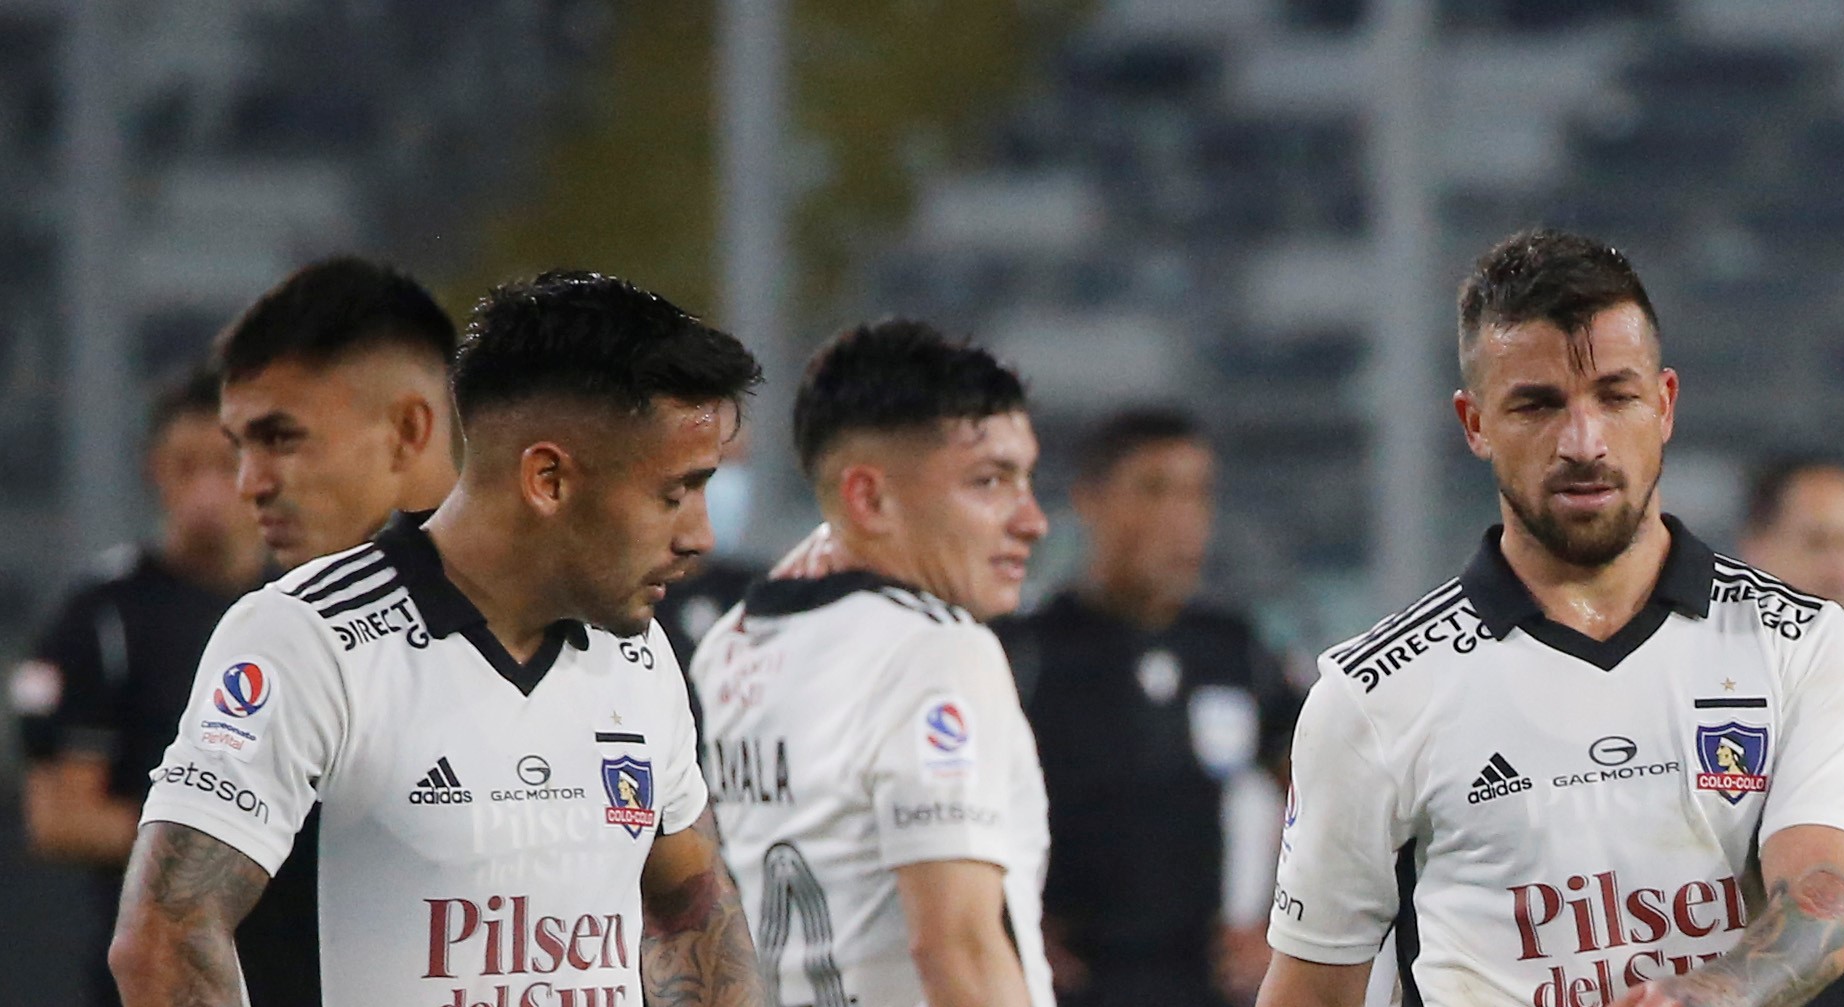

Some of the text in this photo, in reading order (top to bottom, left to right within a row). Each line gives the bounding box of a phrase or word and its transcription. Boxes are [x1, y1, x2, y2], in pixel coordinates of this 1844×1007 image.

[1711, 585, 1815, 625] IRECTV
[331, 597, 415, 651] DIRECT
[406, 624, 430, 650] G
[1761, 610, 1802, 641] GO
[619, 642, 655, 670] GO
[1600, 762, 1681, 783] MOTOR
[1699, 774, 1767, 791] COLO-COLO
[408, 787, 473, 804] adidas
[531, 788, 587, 801] MOTOR
[1467, 776, 1533, 804] adidas
[607, 809, 653, 824] COLO-COLO
[420, 894, 630, 978] Pilsen
